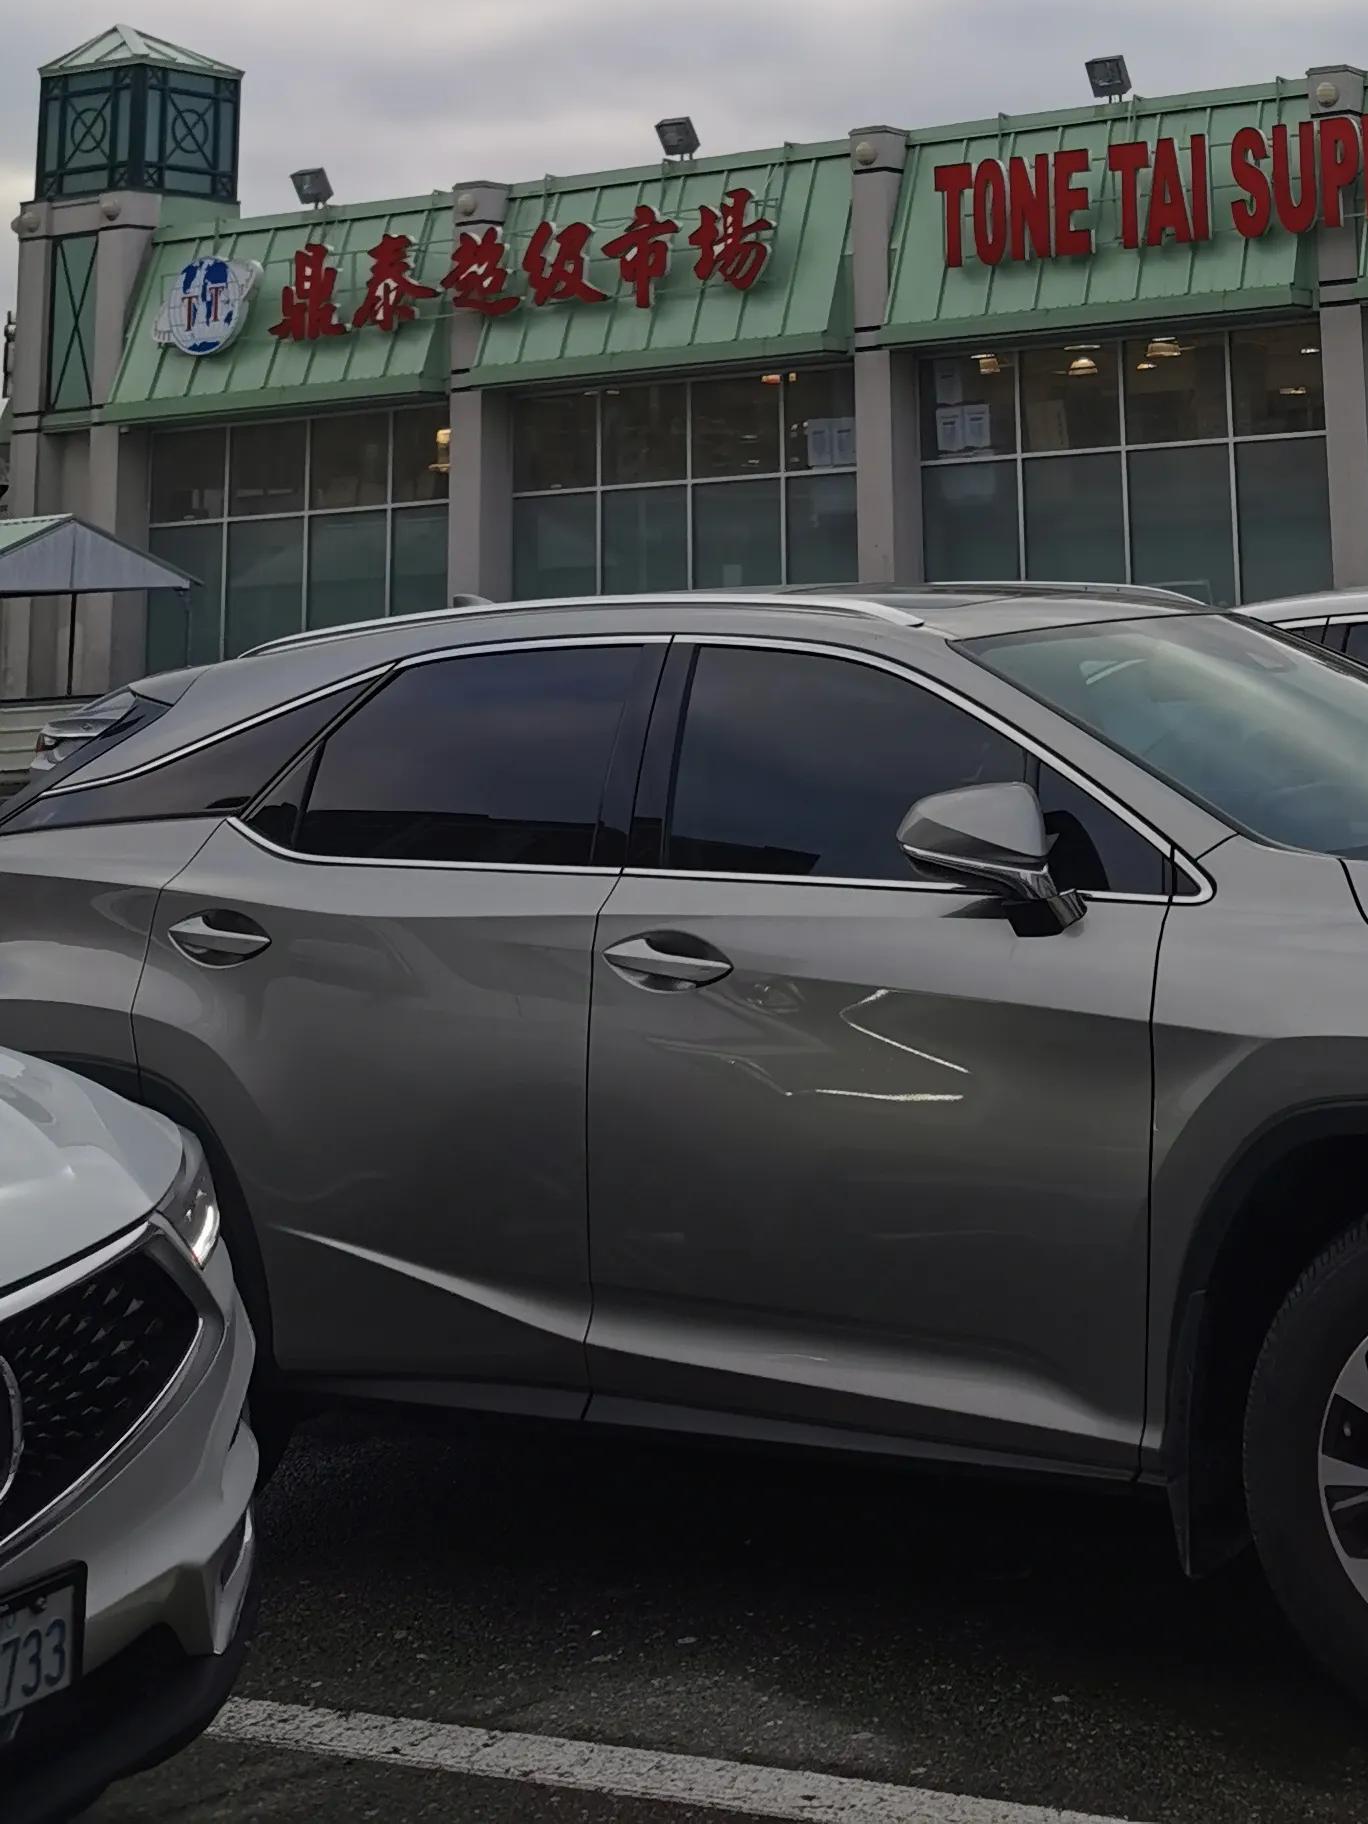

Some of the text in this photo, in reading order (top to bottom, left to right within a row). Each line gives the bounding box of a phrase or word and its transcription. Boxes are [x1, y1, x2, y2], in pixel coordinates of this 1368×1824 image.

[934, 149, 1094, 268] TONE
[1108, 133, 1212, 250] TAI
[1, 1618, 66, 1708] 733
